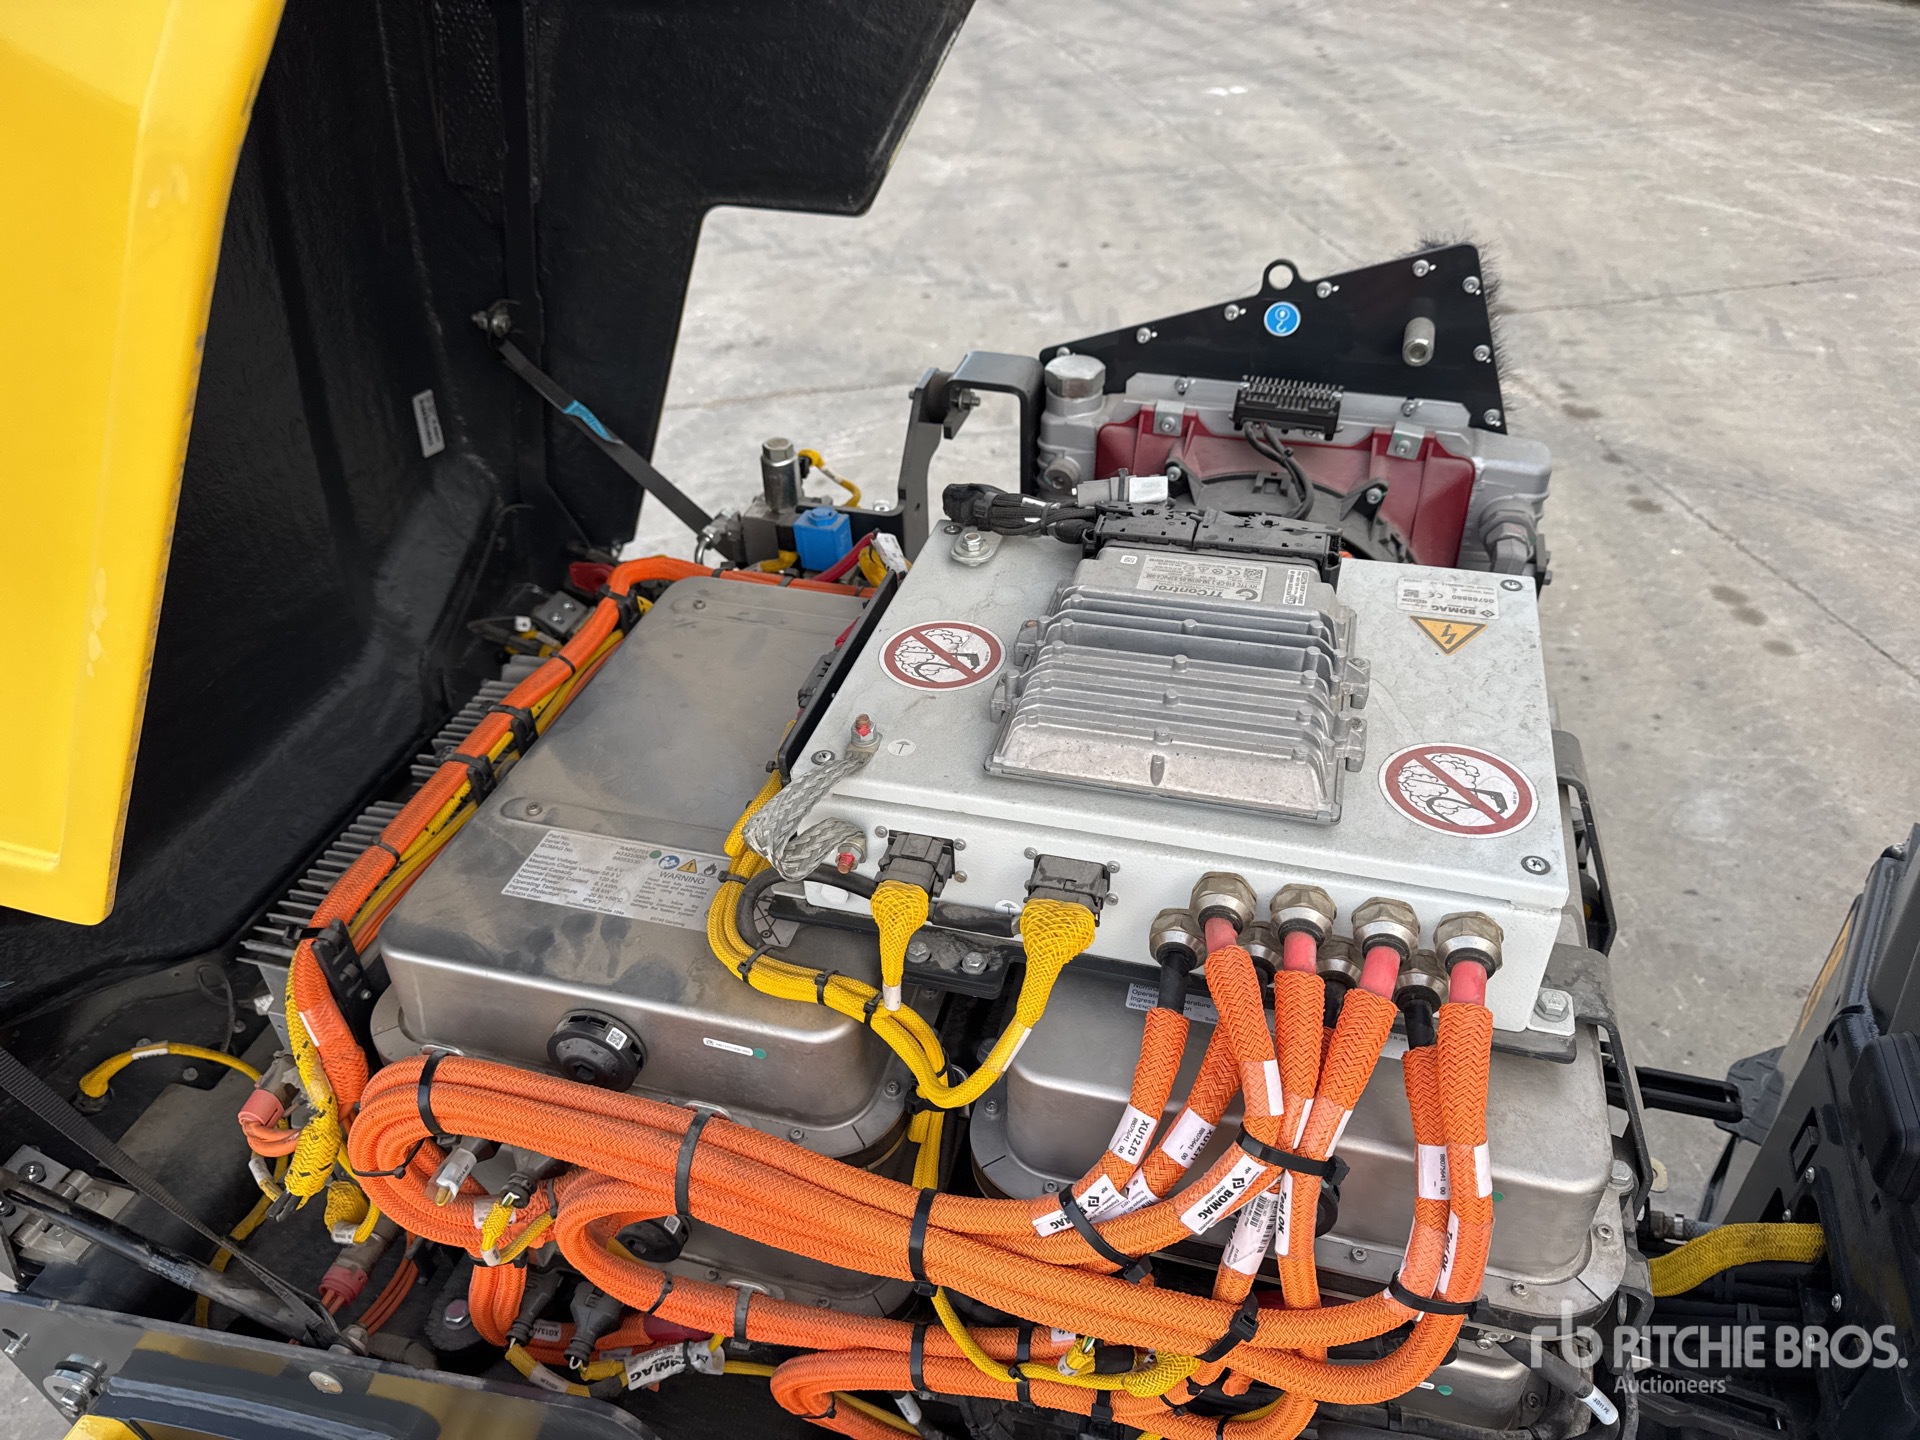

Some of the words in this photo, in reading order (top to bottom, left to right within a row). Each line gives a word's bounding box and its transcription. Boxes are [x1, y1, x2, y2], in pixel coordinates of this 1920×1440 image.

[1432, 605, 1476, 615] BOMAG
[658, 871, 706, 884] WARNING
[1198, 1189, 1234, 1220] BOMAG
